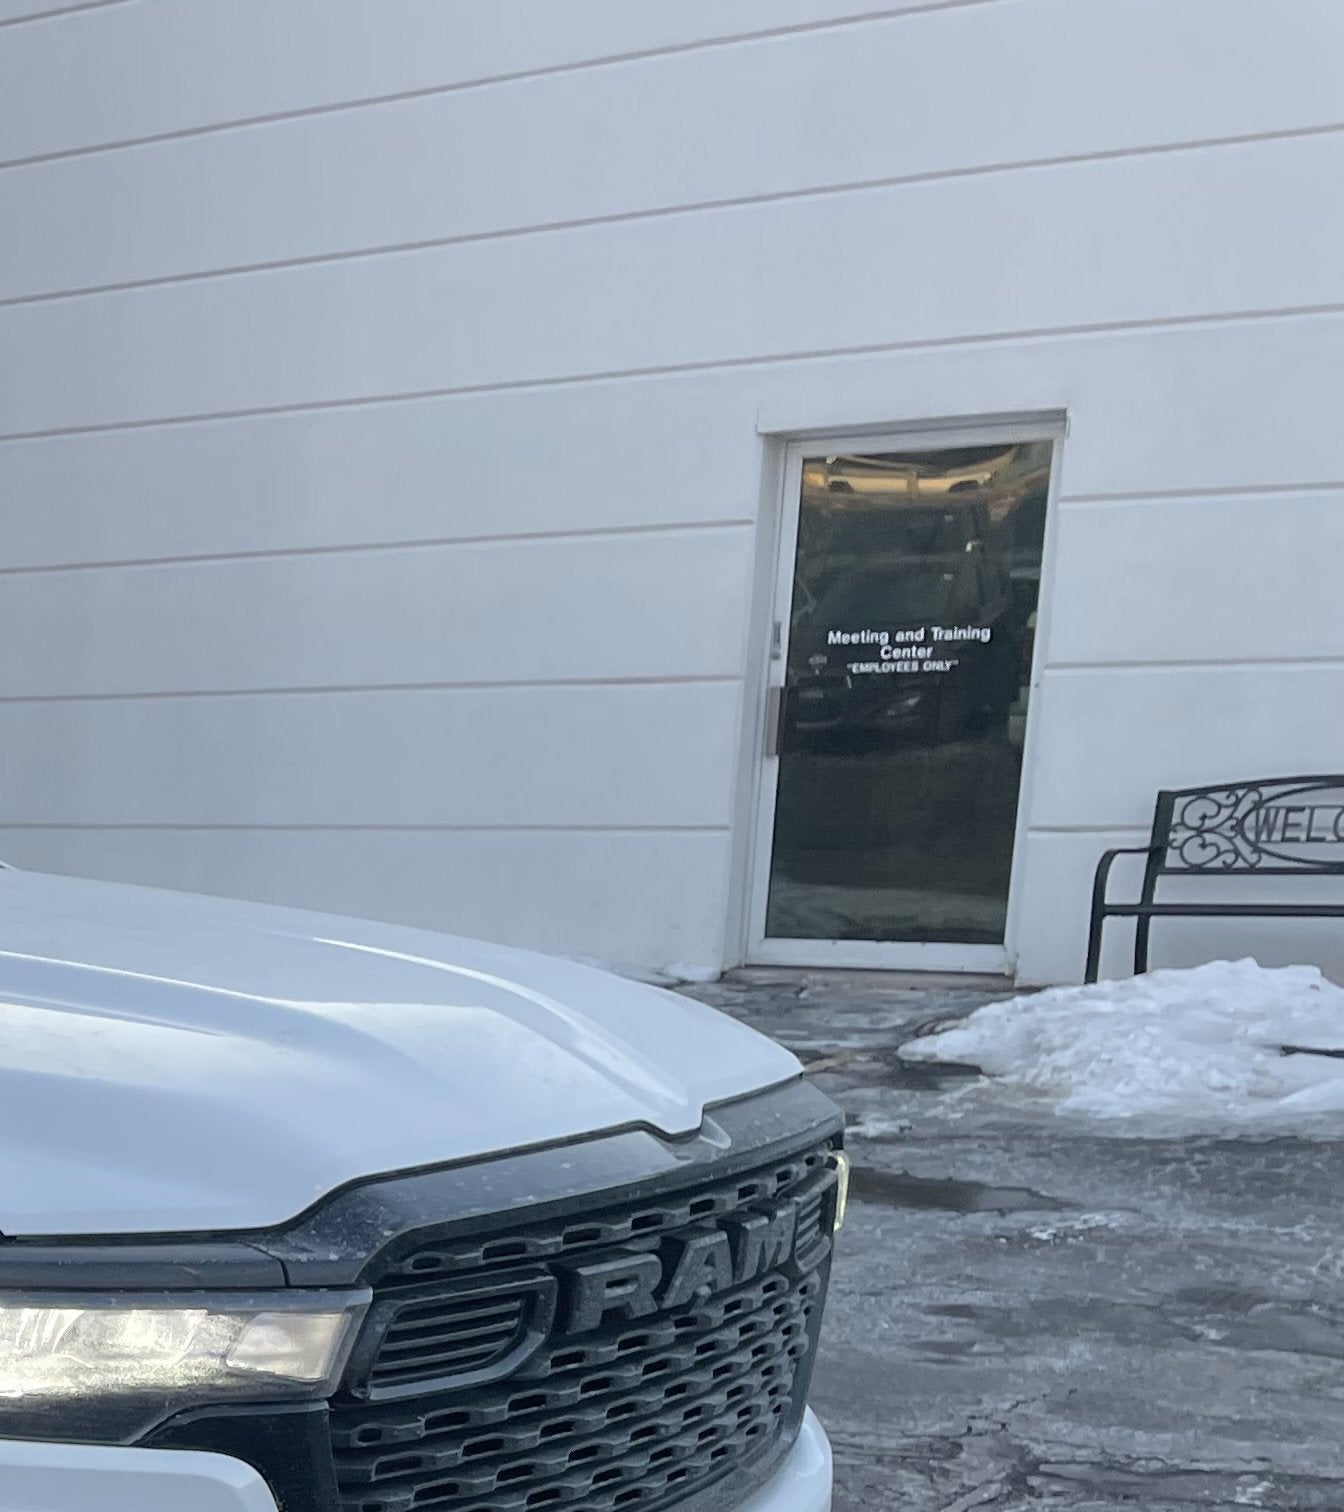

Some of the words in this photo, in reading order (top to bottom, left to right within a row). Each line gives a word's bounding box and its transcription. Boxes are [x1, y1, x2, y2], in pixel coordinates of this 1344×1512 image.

[827, 629, 889, 645] Meeting
[895, 626, 925, 642] and
[931, 625, 991, 642] Training
[880, 645, 934, 660] Center
[566, 1194, 797, 1335] RAM
